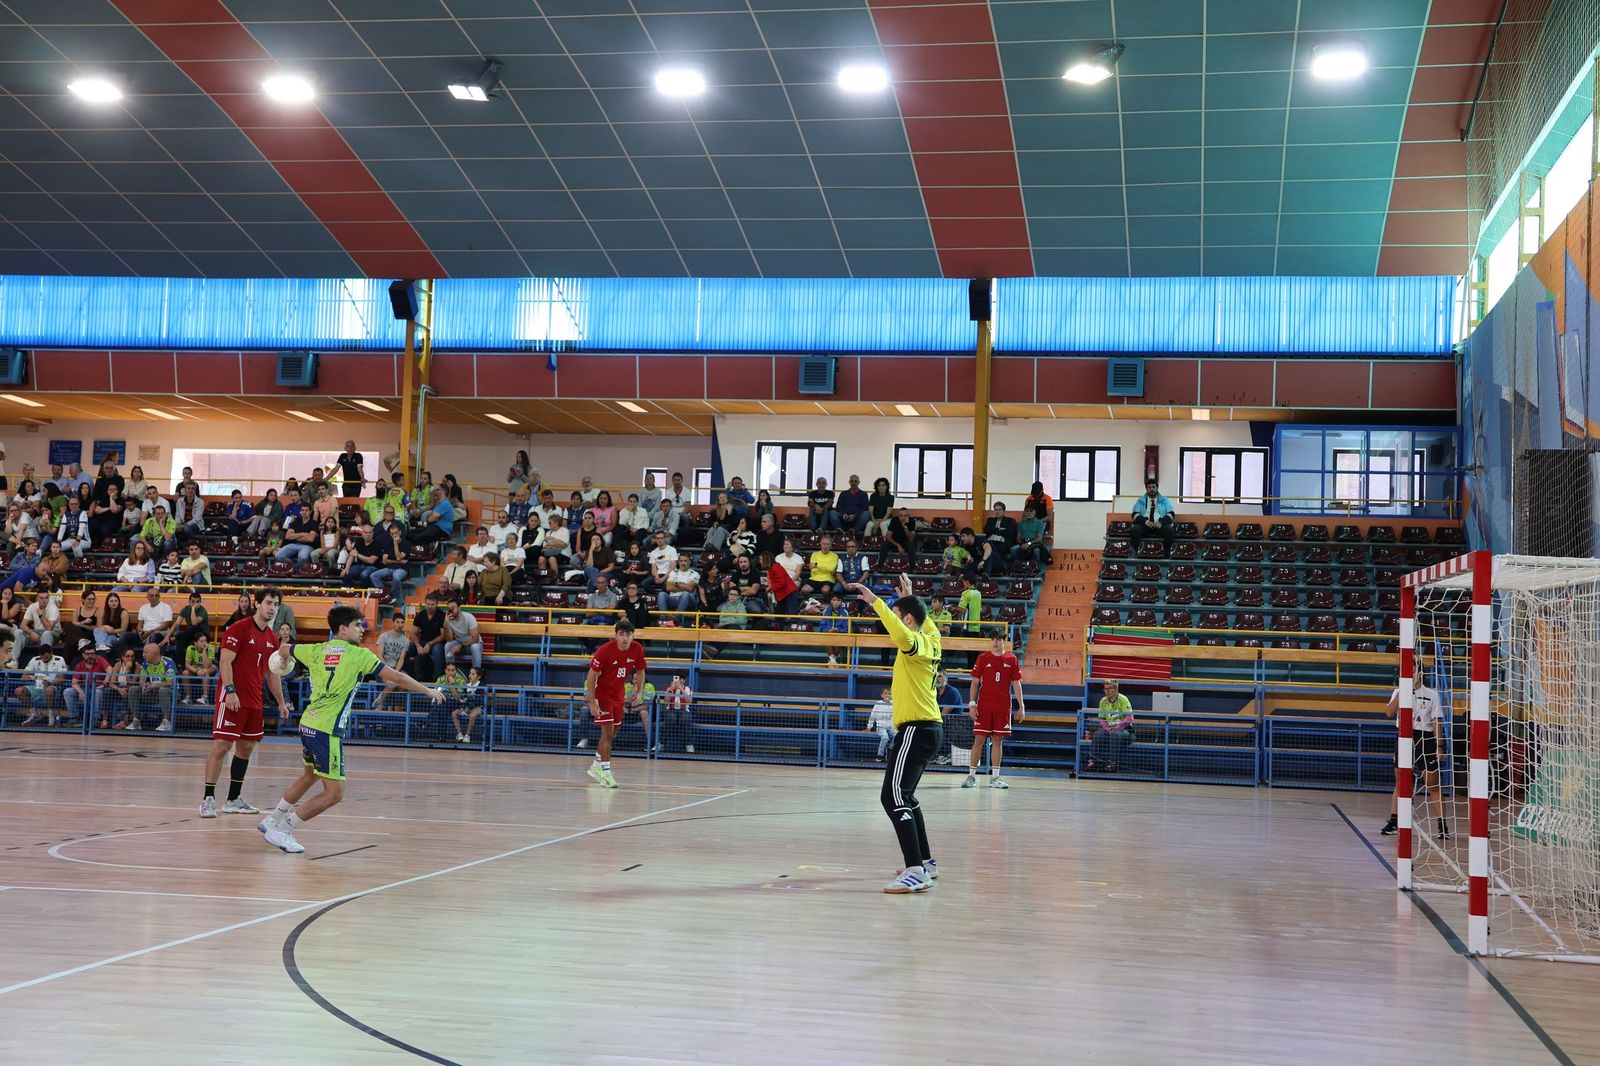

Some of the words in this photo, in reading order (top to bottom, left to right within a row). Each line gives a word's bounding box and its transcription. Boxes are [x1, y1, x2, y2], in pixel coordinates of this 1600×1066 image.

[1048, 608, 1071, 616] FILA
[1041, 632, 1065, 640] FILA
[1036, 658, 1059, 667] FILA
[617, 667, 626, 678] 99
[995, 672, 1000, 682] 8
[326, 666, 336, 692] 7
